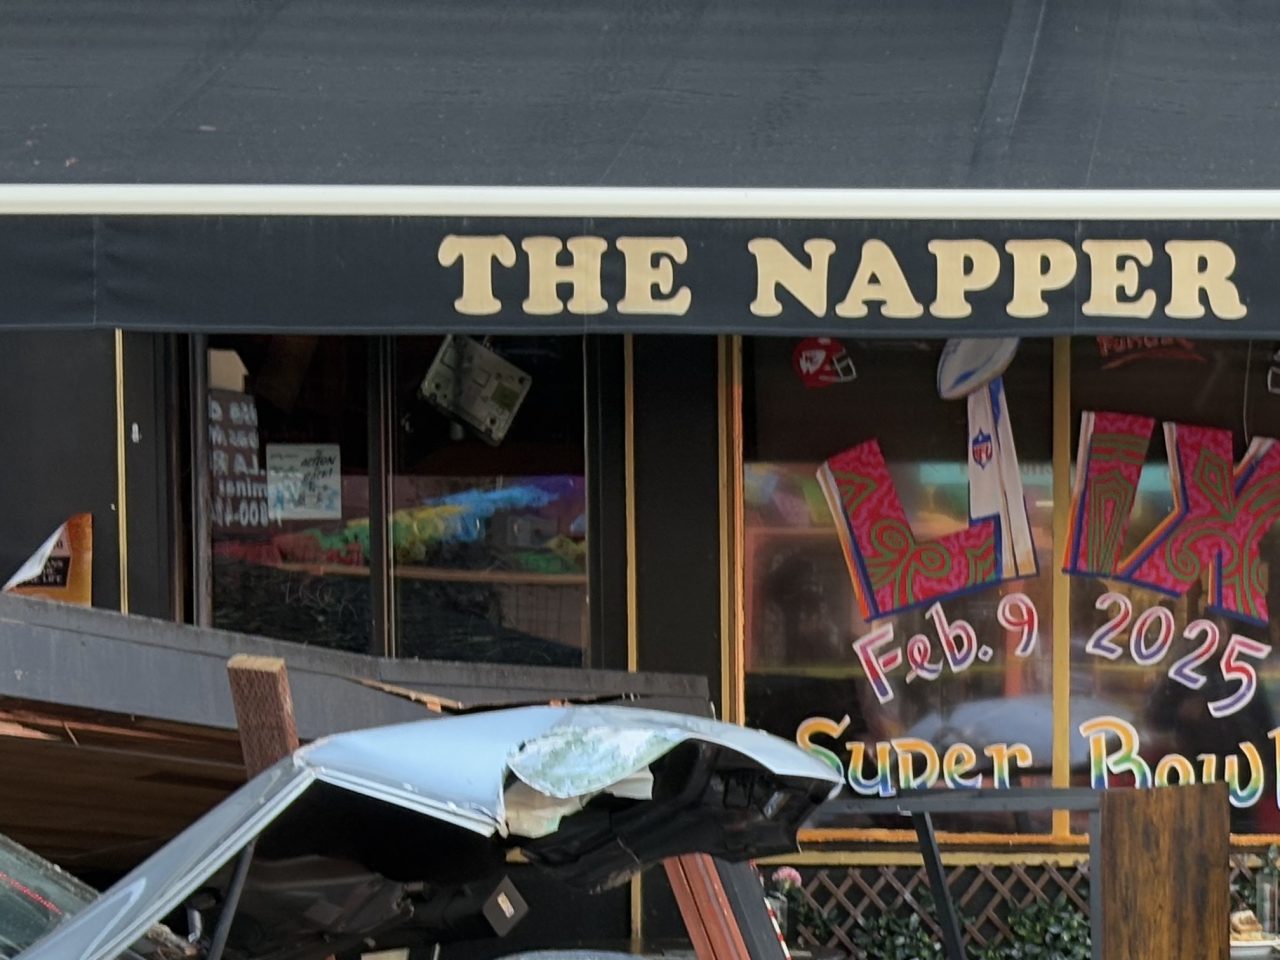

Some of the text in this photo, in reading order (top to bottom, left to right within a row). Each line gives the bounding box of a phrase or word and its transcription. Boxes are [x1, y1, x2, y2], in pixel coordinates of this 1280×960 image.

[438, 235, 692, 316] THE
[747, 238, 1248, 320] NAPPER
[853, 592, 1273, 719] Feb. 9 2025
